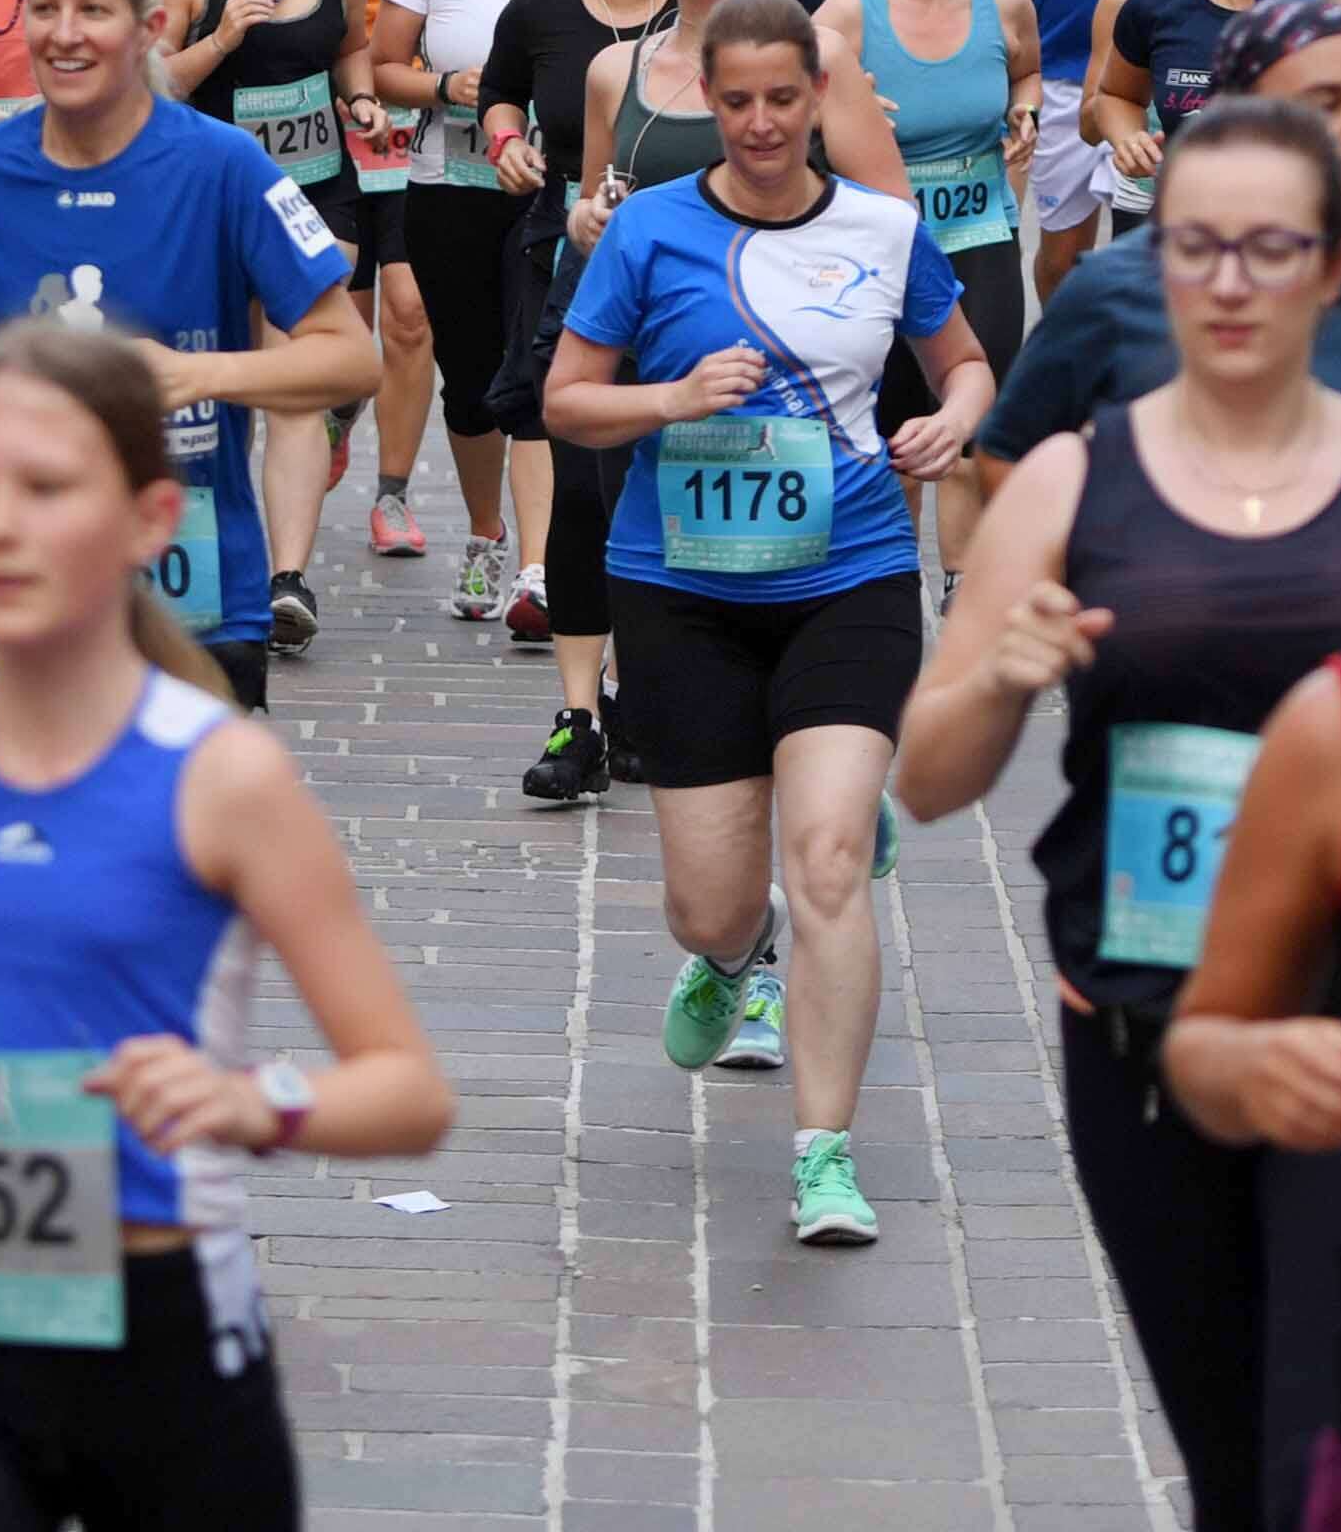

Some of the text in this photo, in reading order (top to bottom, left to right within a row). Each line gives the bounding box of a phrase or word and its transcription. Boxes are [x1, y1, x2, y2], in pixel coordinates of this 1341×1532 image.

[255, 111, 329, 155] 1278
[914, 181, 989, 221] 1029
[684, 469, 808, 522] 1178
